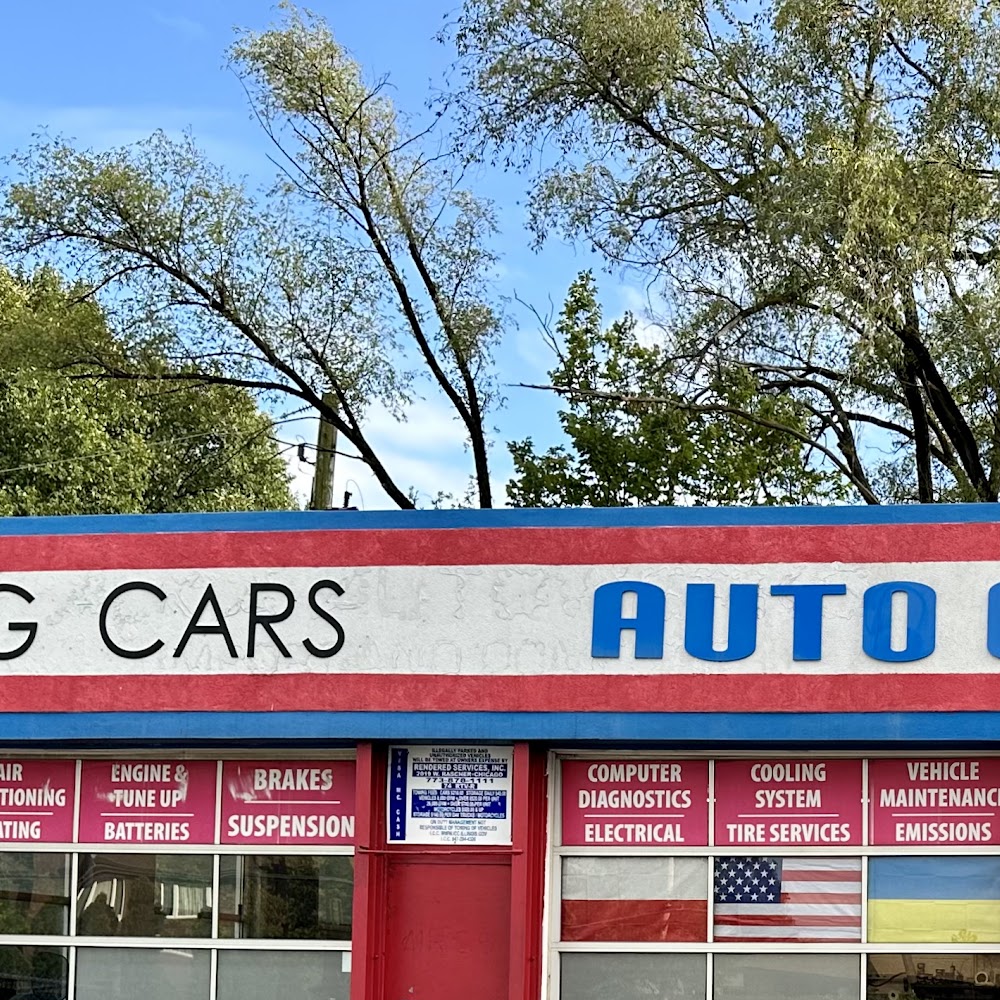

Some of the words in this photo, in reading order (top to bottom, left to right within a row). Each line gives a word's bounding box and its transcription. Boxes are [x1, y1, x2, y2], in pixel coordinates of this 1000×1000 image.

[0, 583, 37, 660] G
[100, 580, 345, 660] CARS
[591, 581, 935, 661] AUTO
[111, 764, 170, 783] ENGINE
[174, 765, 189, 782] &
[453, 764, 490, 772] SERVICES,
[587, 764, 682, 783] COMPUTER
[750, 763, 827, 782] COOLING
[907, 762, 980, 781] VEHICLE
[254, 768, 333, 791] BRAKES
[0, 788, 66, 807] TIONING
[114, 789, 156, 808] TUNE
[160, 790, 183, 808] UP
[578, 790, 692, 809] DIAGNOSTICS
[755, 789, 822, 809] SYSTEM
[104, 822, 190, 841] BATTERIES
[228, 815, 355, 838] SUSPENSION
[584, 823, 685, 843] ELECTRICAL
[726, 823, 766, 843] TIRE
[770, 823, 851, 843] SERVICES
[895, 822, 992, 842] EMISSIONS
